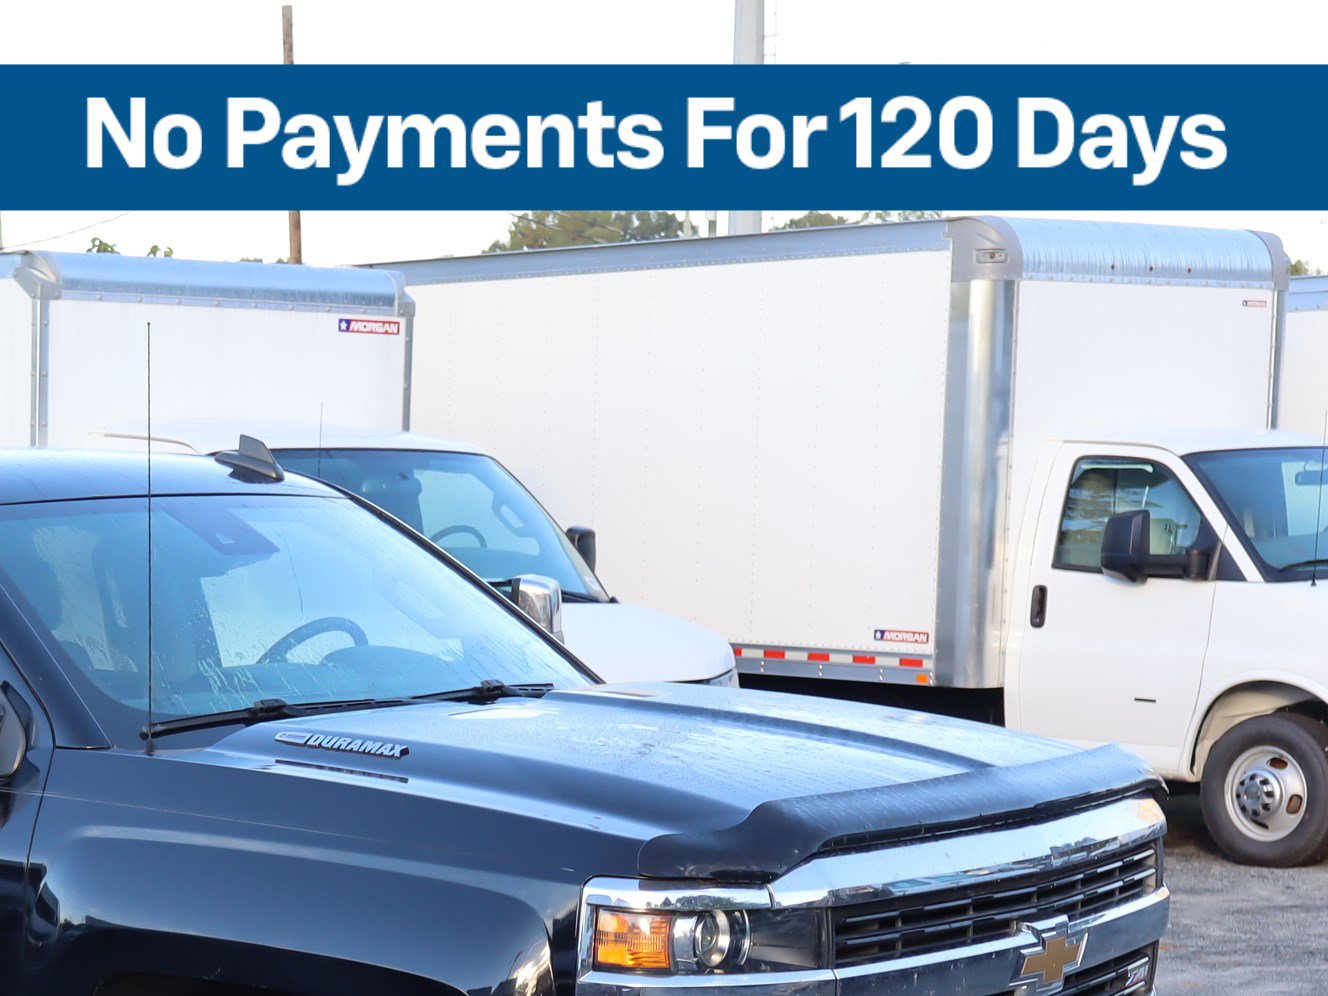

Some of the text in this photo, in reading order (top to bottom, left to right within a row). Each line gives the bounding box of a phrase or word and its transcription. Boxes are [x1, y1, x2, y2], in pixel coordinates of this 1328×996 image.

[349, 321, 399, 334] MORGAN
[883, 630, 927, 643] MORGAN
[307, 733, 410, 759] DURAMAX
